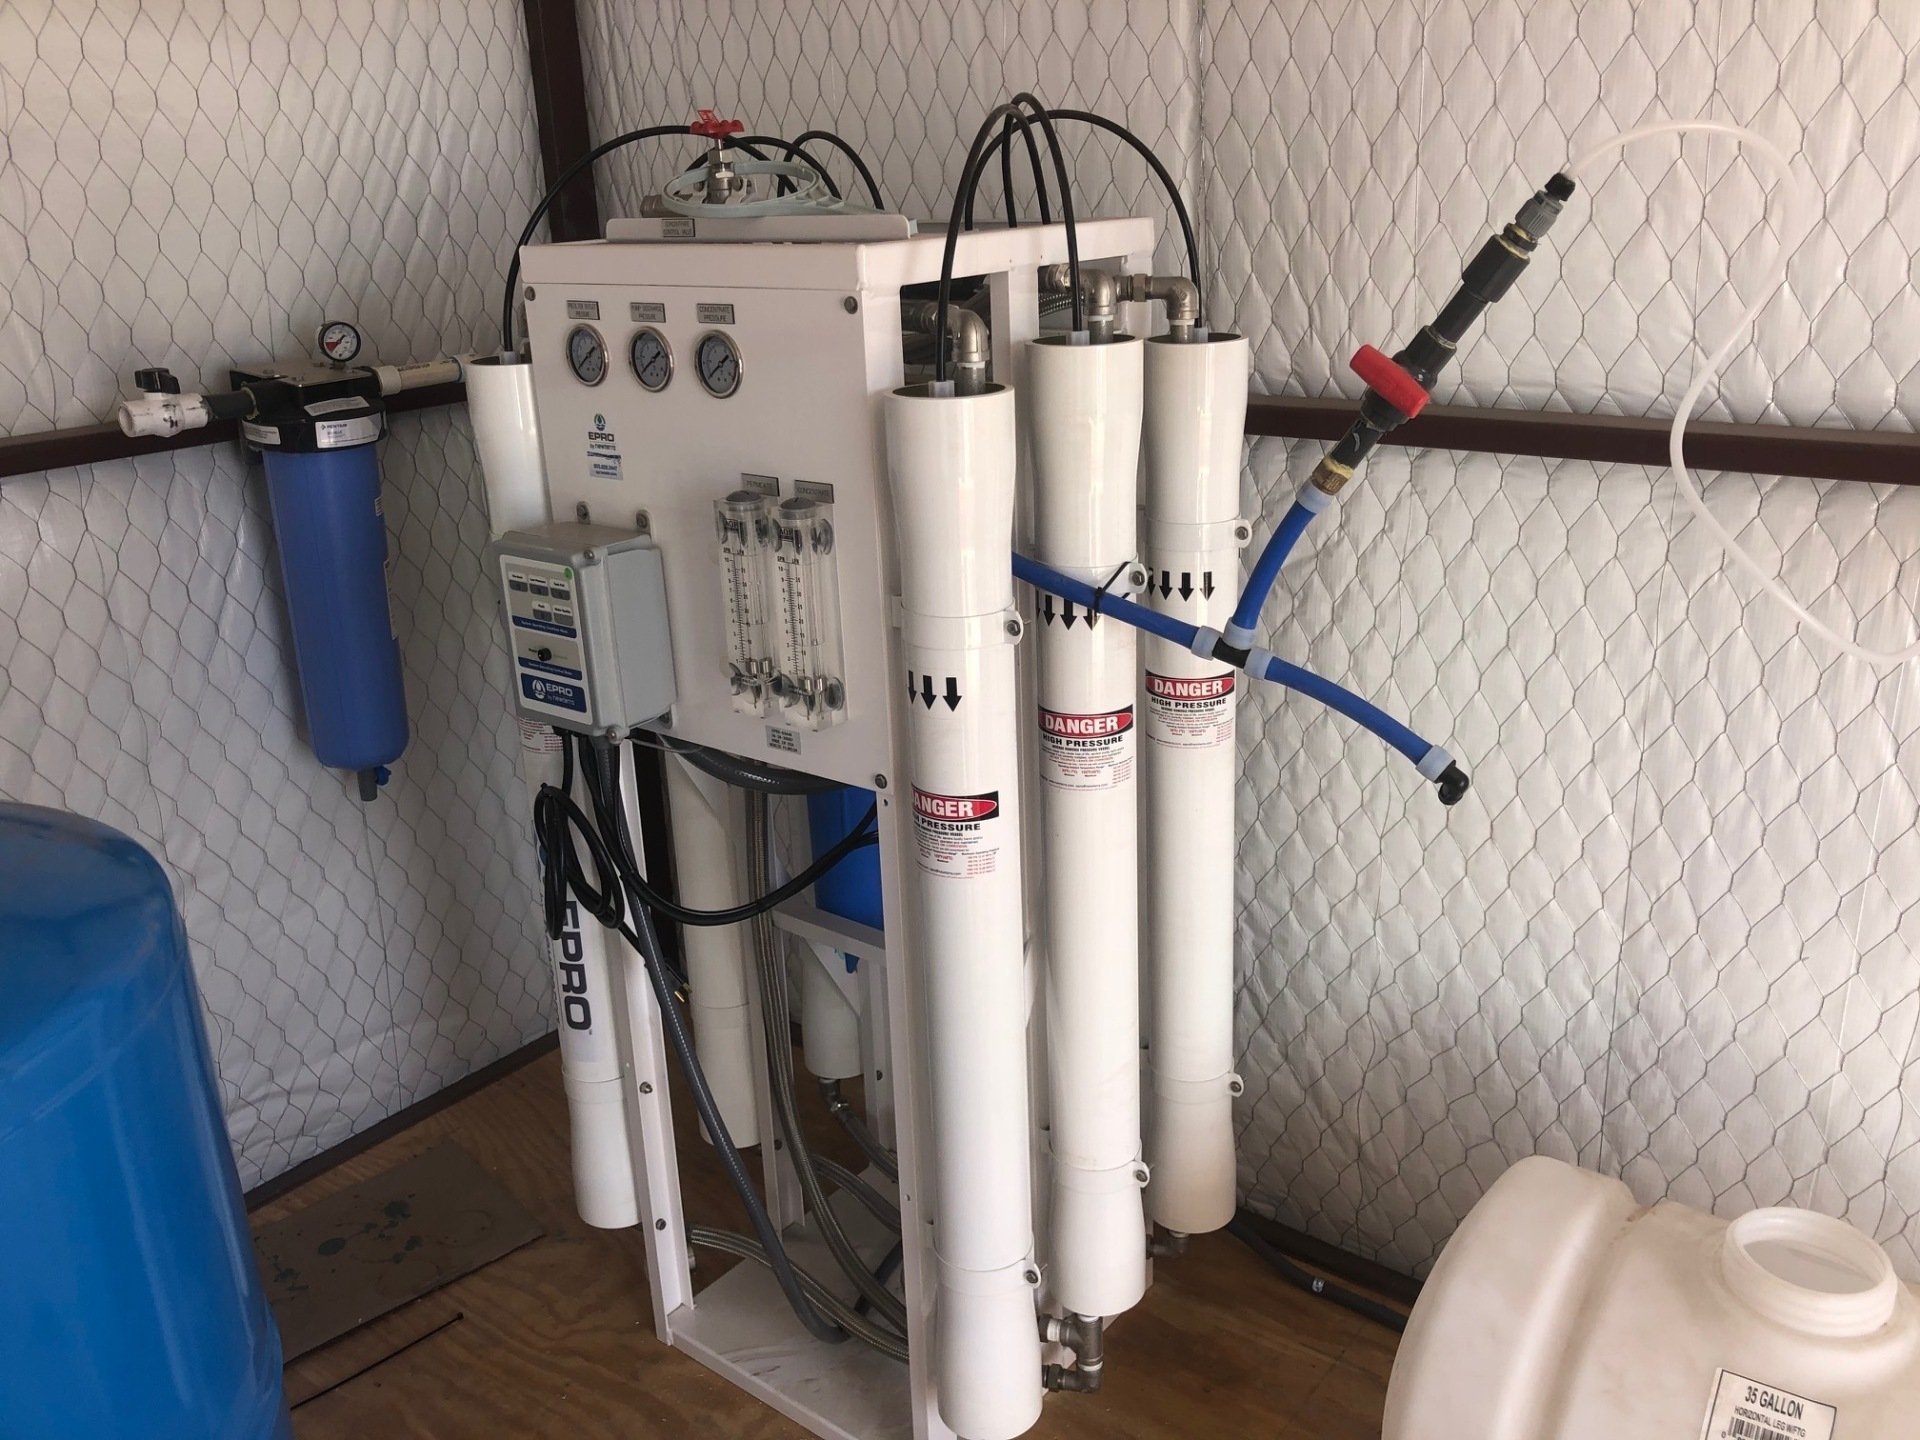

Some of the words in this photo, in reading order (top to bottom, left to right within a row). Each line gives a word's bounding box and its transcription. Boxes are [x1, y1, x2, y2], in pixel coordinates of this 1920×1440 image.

[588, 431, 615, 442] EPRO
[545, 683, 573, 697] EPRO
[1154, 679, 1223, 696] DANGER
[1151, 696, 1171, 707] HIGH
[1175, 697, 1227, 709] PRESSURE
[1045, 714, 1119, 734] DANGER
[1042, 734, 1062, 745] HIGH
[1066, 735, 1123, 747] PRESSURE
[912, 789, 974, 817] ANGER
[921, 817, 981, 831] PRESSURE
[559, 901, 592, 1030] EPRO
[1745, 1385, 1758, 1404] 35
[1760, 1391, 1804, 1420] GALLON
[1734, 1405, 1771, 1427] HORIZONTAL
[1772, 1419, 1786, 1431] LEG
